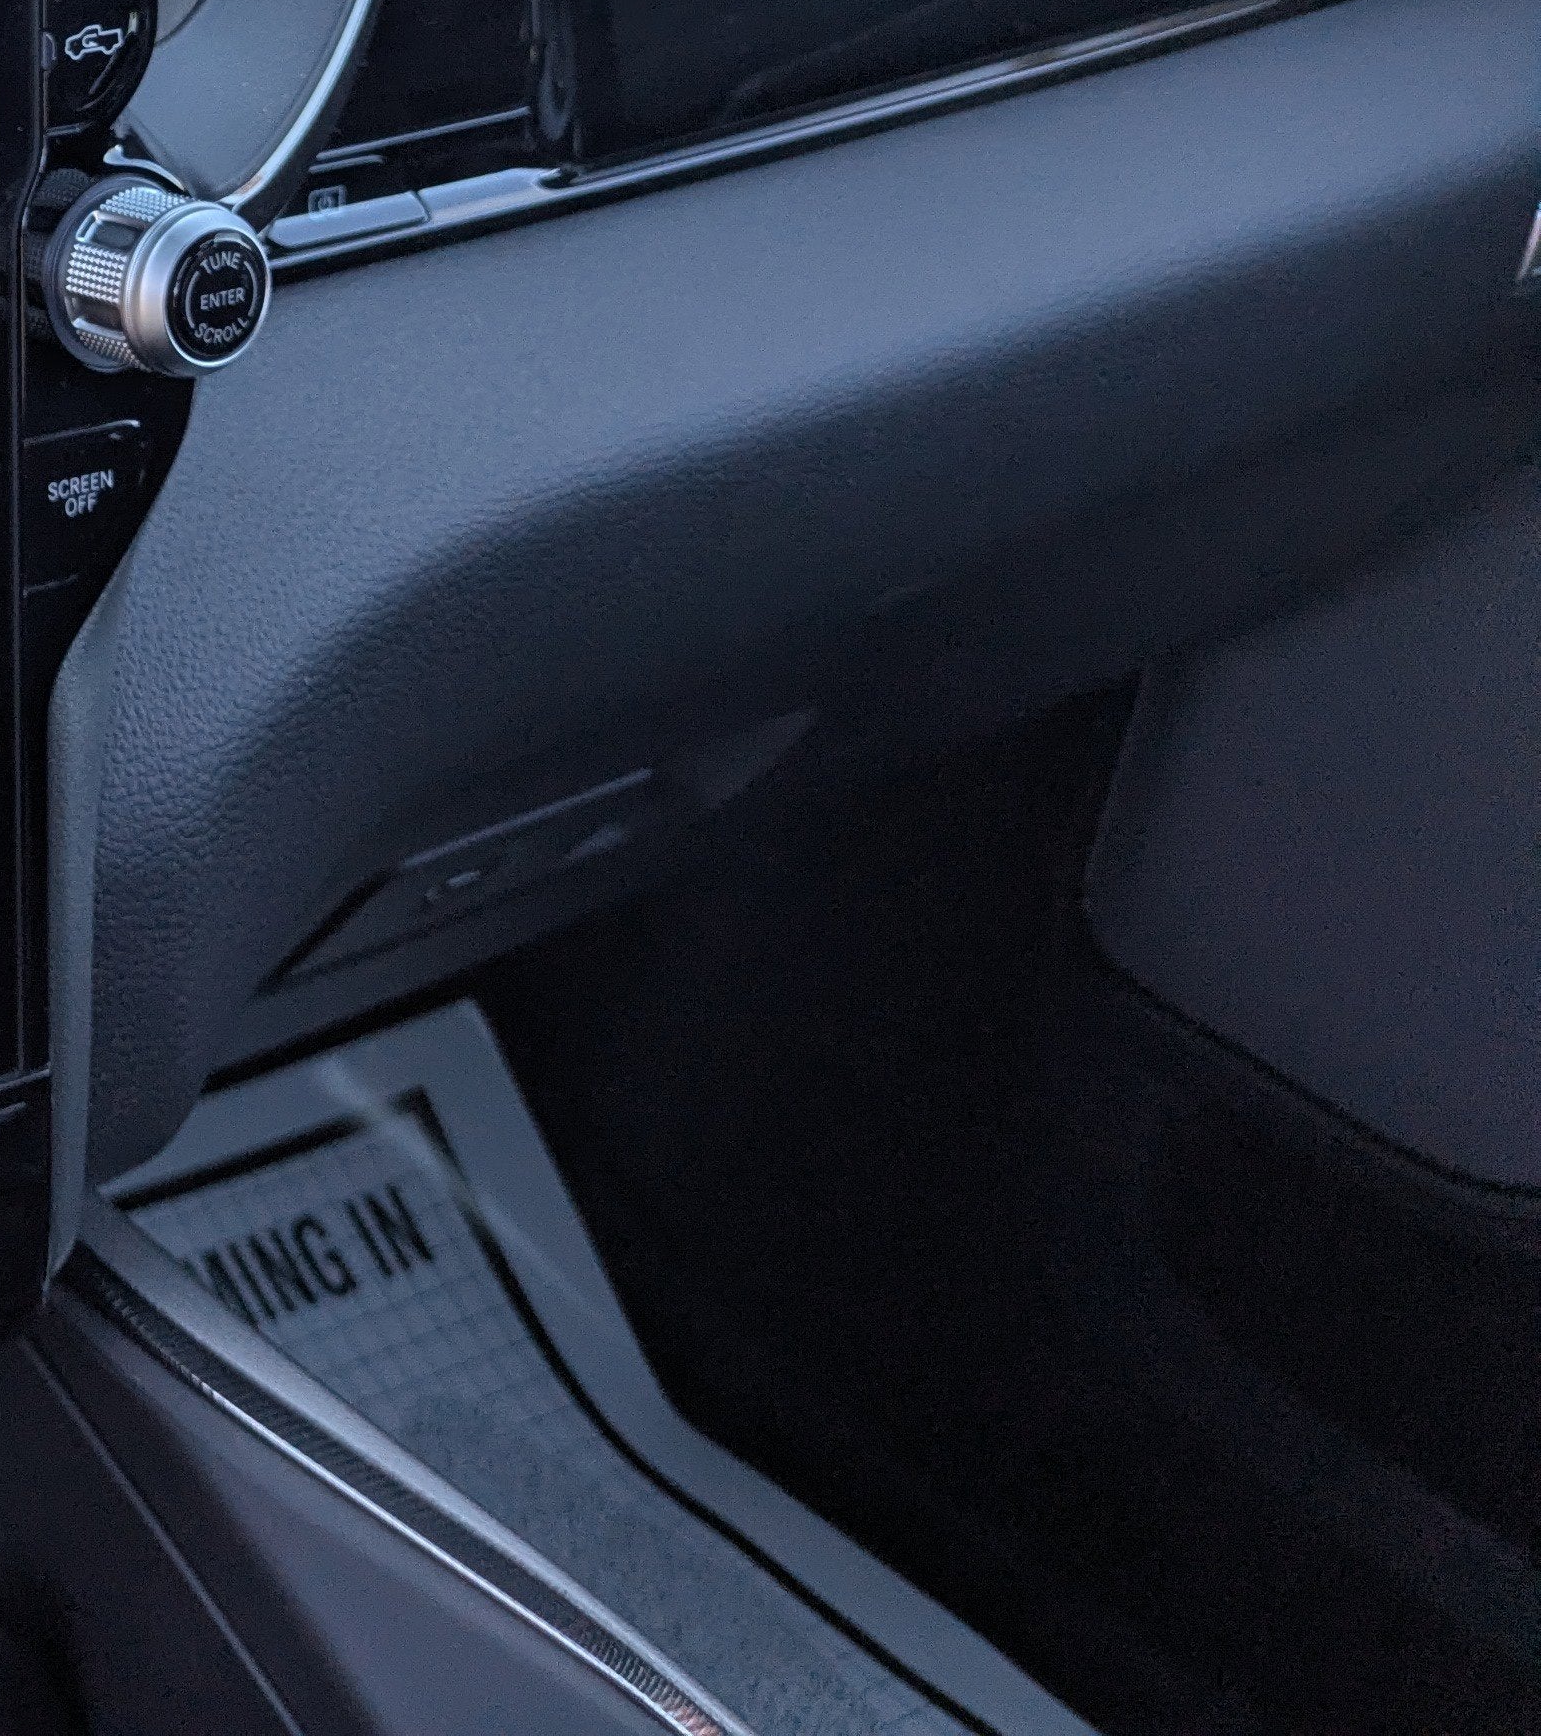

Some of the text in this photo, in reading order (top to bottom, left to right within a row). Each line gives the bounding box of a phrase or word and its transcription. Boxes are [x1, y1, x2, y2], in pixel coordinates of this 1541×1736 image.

[200, 250, 242, 274] TUNE
[200, 286, 246, 311] ENTER
[194, 313, 251, 346] SCROLL
[47, 468, 115, 503] SCREEN
[64, 491, 99, 518] OFF
[344, 1181, 436, 1279] IN
